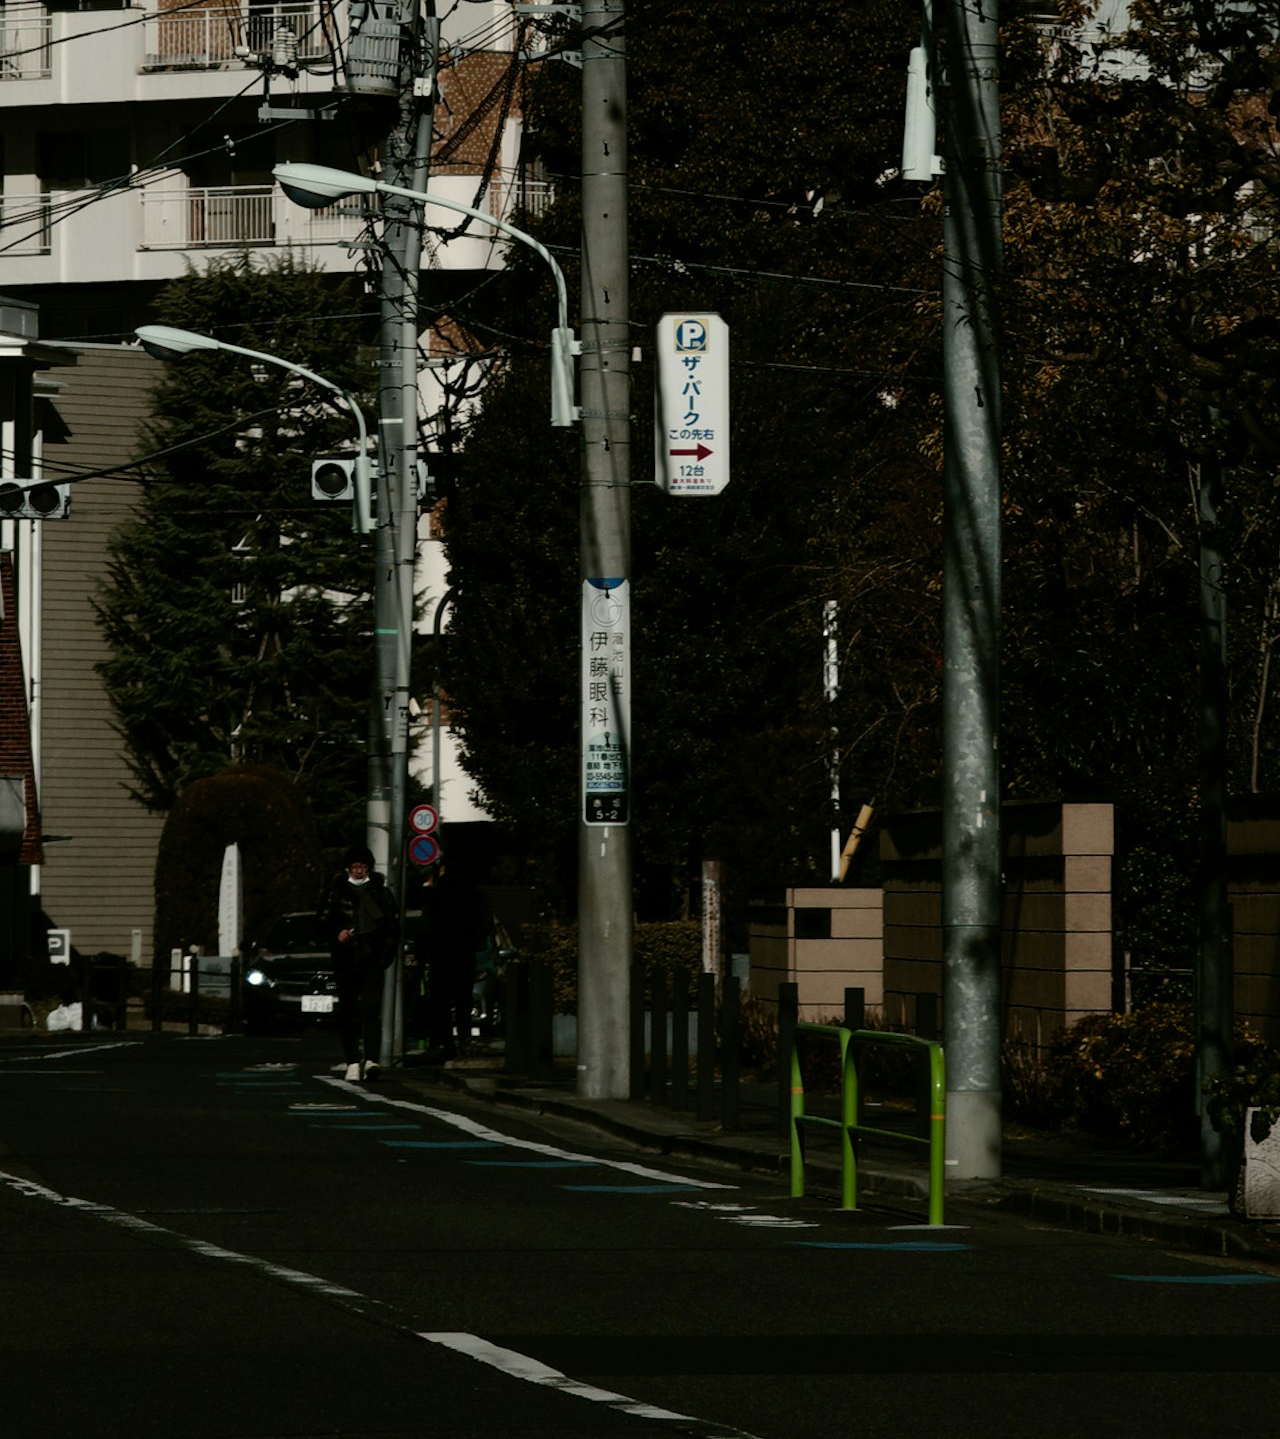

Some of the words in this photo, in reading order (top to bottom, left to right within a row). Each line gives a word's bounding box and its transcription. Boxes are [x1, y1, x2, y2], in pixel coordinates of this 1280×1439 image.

[681, 356, 702, 427] ザ・パーク
[669, 429, 714, 441] この先右
[680, 465, 705, 477] 12台
[589, 631, 609, 729] 伊藤眼科
[415, 813, 432, 826] 30
[596, 810, 618, 820] 5-2
